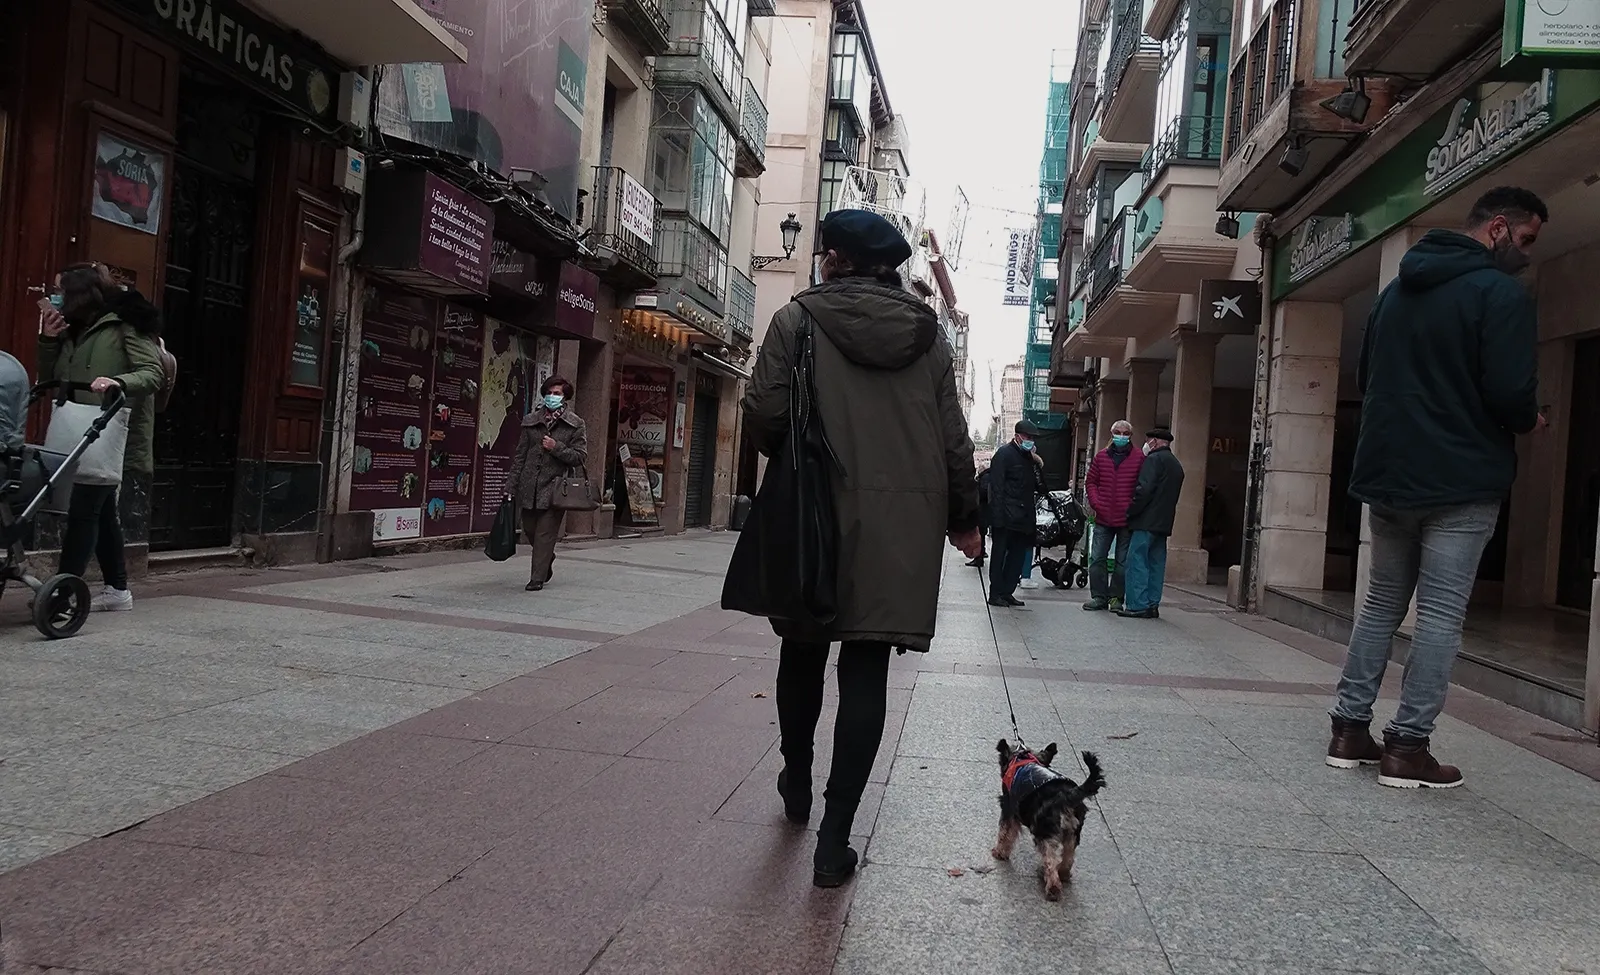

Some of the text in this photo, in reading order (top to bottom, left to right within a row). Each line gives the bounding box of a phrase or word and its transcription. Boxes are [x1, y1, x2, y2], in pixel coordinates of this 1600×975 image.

[560, 70, 580, 106] CAJA
[117, 159, 149, 185] SORIA
[620, 383, 667, 393] DEGUSTACIÓN
[620, 427, 661, 441] MUÑOZ
